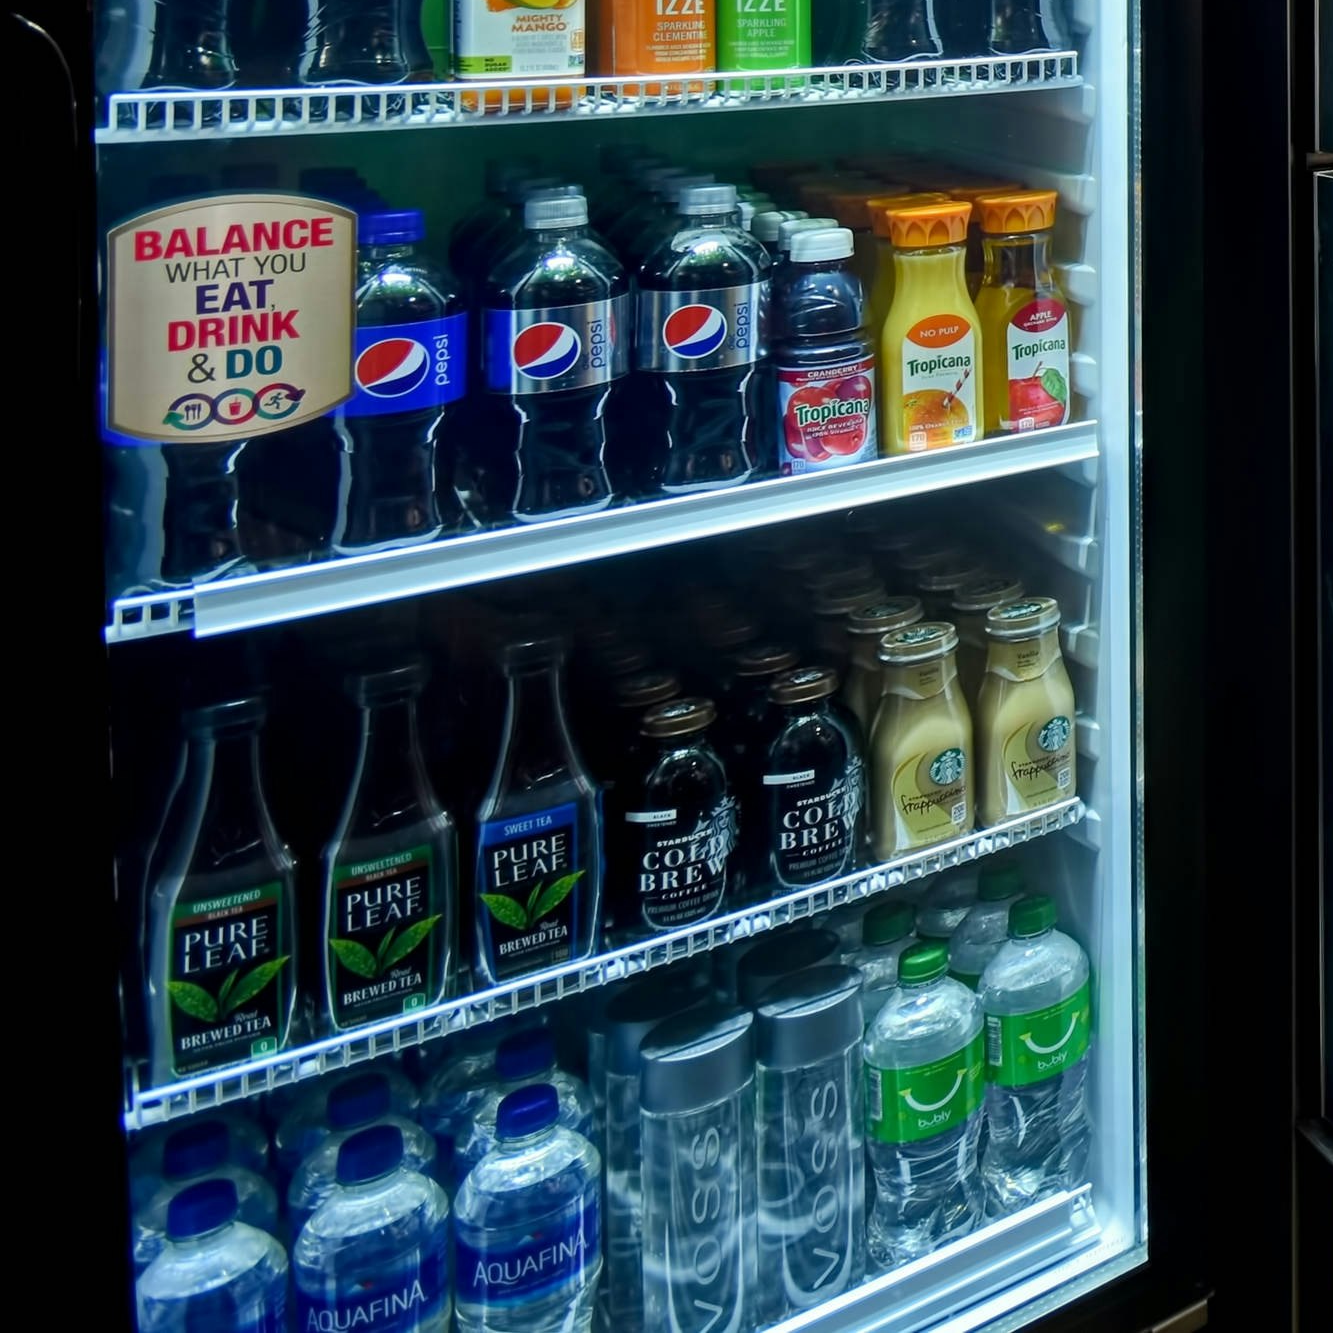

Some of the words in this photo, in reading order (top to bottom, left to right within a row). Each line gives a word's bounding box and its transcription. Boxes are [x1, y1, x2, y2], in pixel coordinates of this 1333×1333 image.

[510, 21, 567, 33] MANGO
[515, 14, 563, 24] MIGHTY
[656, 20, 706, 32] SPARKLING
[736, 17, 787, 28] SPARKLING
[746, 27, 776, 38] APPLE
[134, 217, 334, 262] BALANCE
[165, 257, 246, 283] WHAT
[254, 252, 306, 277] YOU
[196, 279, 276, 315] EAT,
[167, 309, 300, 352] DRINK
[736, 301, 750, 349] pepsi
[920, 328, 938, 339] NO
[939, 324, 959, 337] PULP
[1029, 310, 1052, 322] APPLE
[434, 333, 449, 387] pepsi
[590, 319, 606, 368] pepsi
[1012, 338, 1066, 361] Tropicana
[188, 353, 216, 383] &
[226, 345, 282, 380] DO
[807, 364, 859, 379] CRANBERRY
[907, 353, 971, 375] Tropicana
[795, 396, 870, 427] Tropicana
[503, 819, 533, 836] SWEET
[535, 814, 552, 828] TEA
[782, 792, 859, 830] COLD
[779, 815, 858, 852] BREW
[351, 851, 412, 876] UNSWEETENED
[492, 833, 566, 871] PURE
[642, 832, 728, 871] COLD
[494, 853, 566, 887] LEAF
[639, 853, 728, 893] BREW
[193, 888, 262, 914] UNSWEETENED
[346, 876, 423, 913] PURE
[661, 883, 708, 901] COFFEE
[346, 898, 421, 933] LEAF
[183, 915, 270, 953] PURE
[499, 931, 545, 956] BREWED
[547, 925, 568, 942] TEA
[182, 939, 268, 974] LEAF
[343, 980, 398, 1006] BREWED
[400, 973, 422, 991] TEA
[181, 1021, 242, 1050] BREWED
[245, 1016, 272, 1034] TEA
[918, 1107, 953, 1131] bubly
[810, 1079, 840, 1290] VOSS
[473, 1232, 587, 1287] AQUAFINA
[306, 1278, 426, 1333] AQUAFINA
